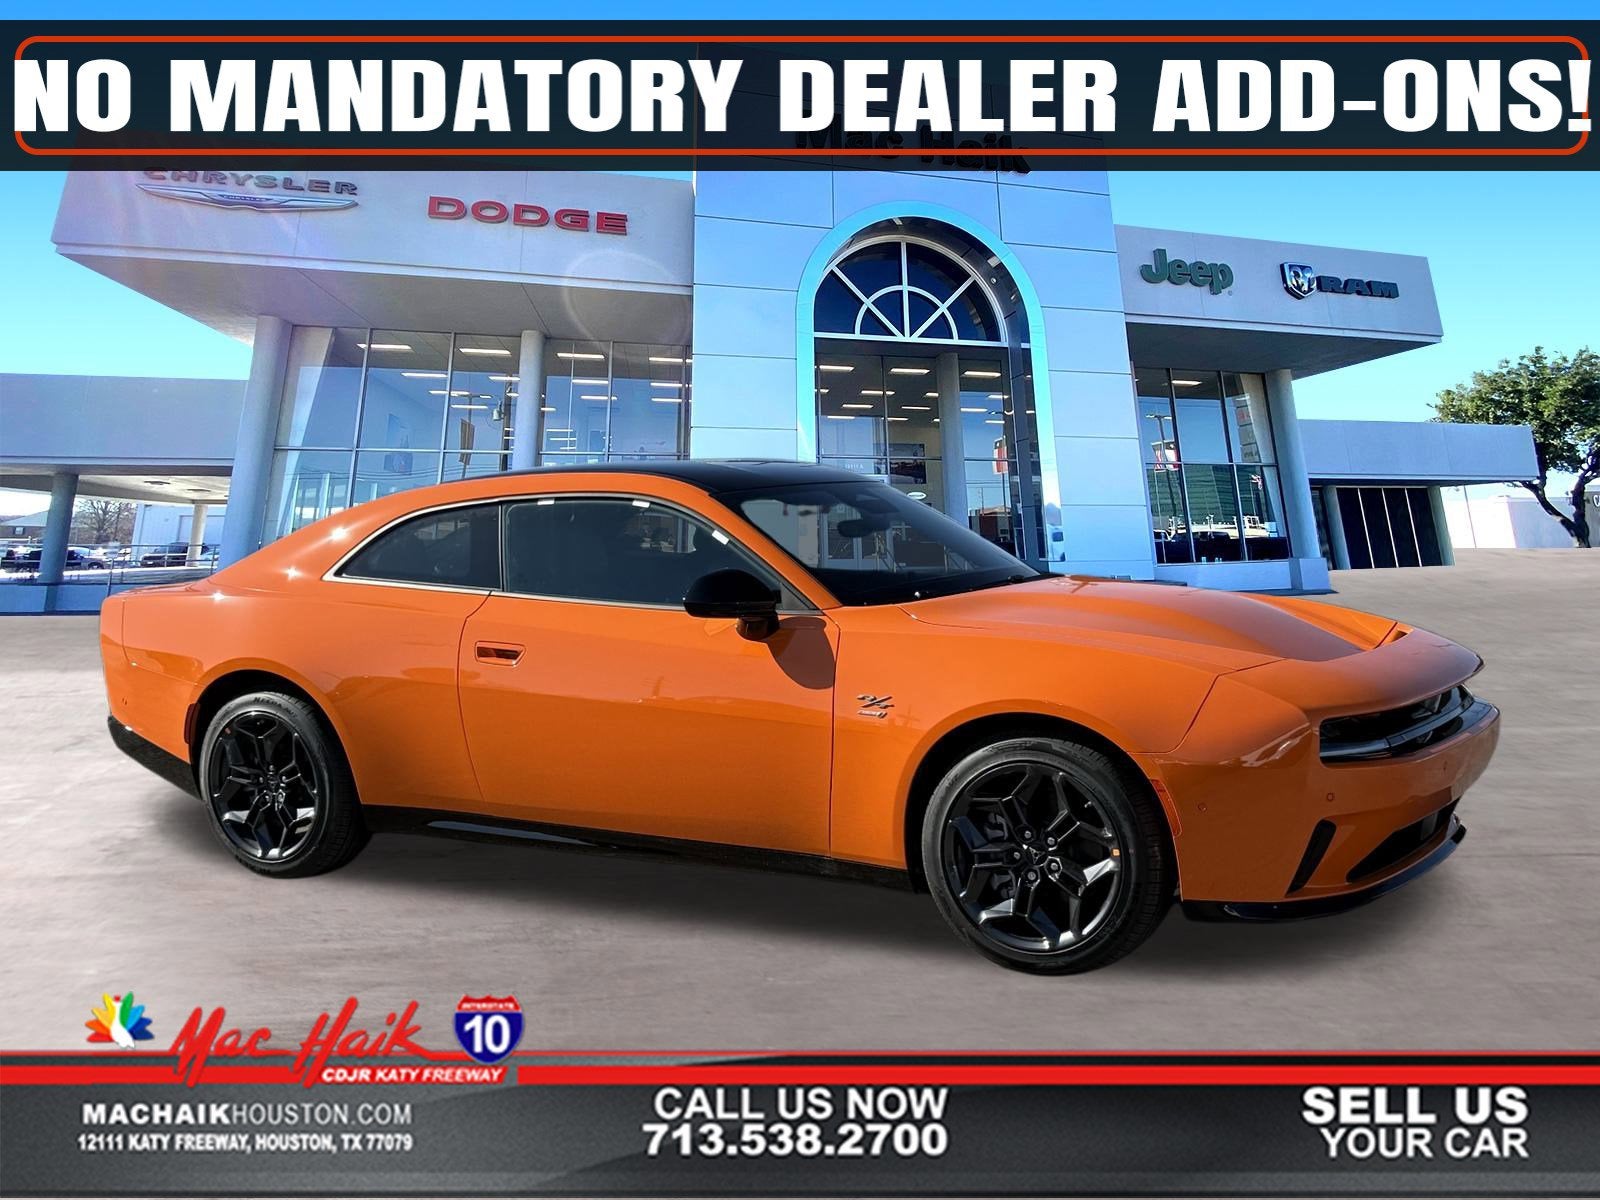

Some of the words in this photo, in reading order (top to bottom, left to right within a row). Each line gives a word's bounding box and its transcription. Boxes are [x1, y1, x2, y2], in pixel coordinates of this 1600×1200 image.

[144, 167, 358, 195] CHRYSLER
[428, 196, 628, 236] DODGE
[1140, 248, 1234, 295] Jeep
[1317, 275, 1399, 299] RAM
